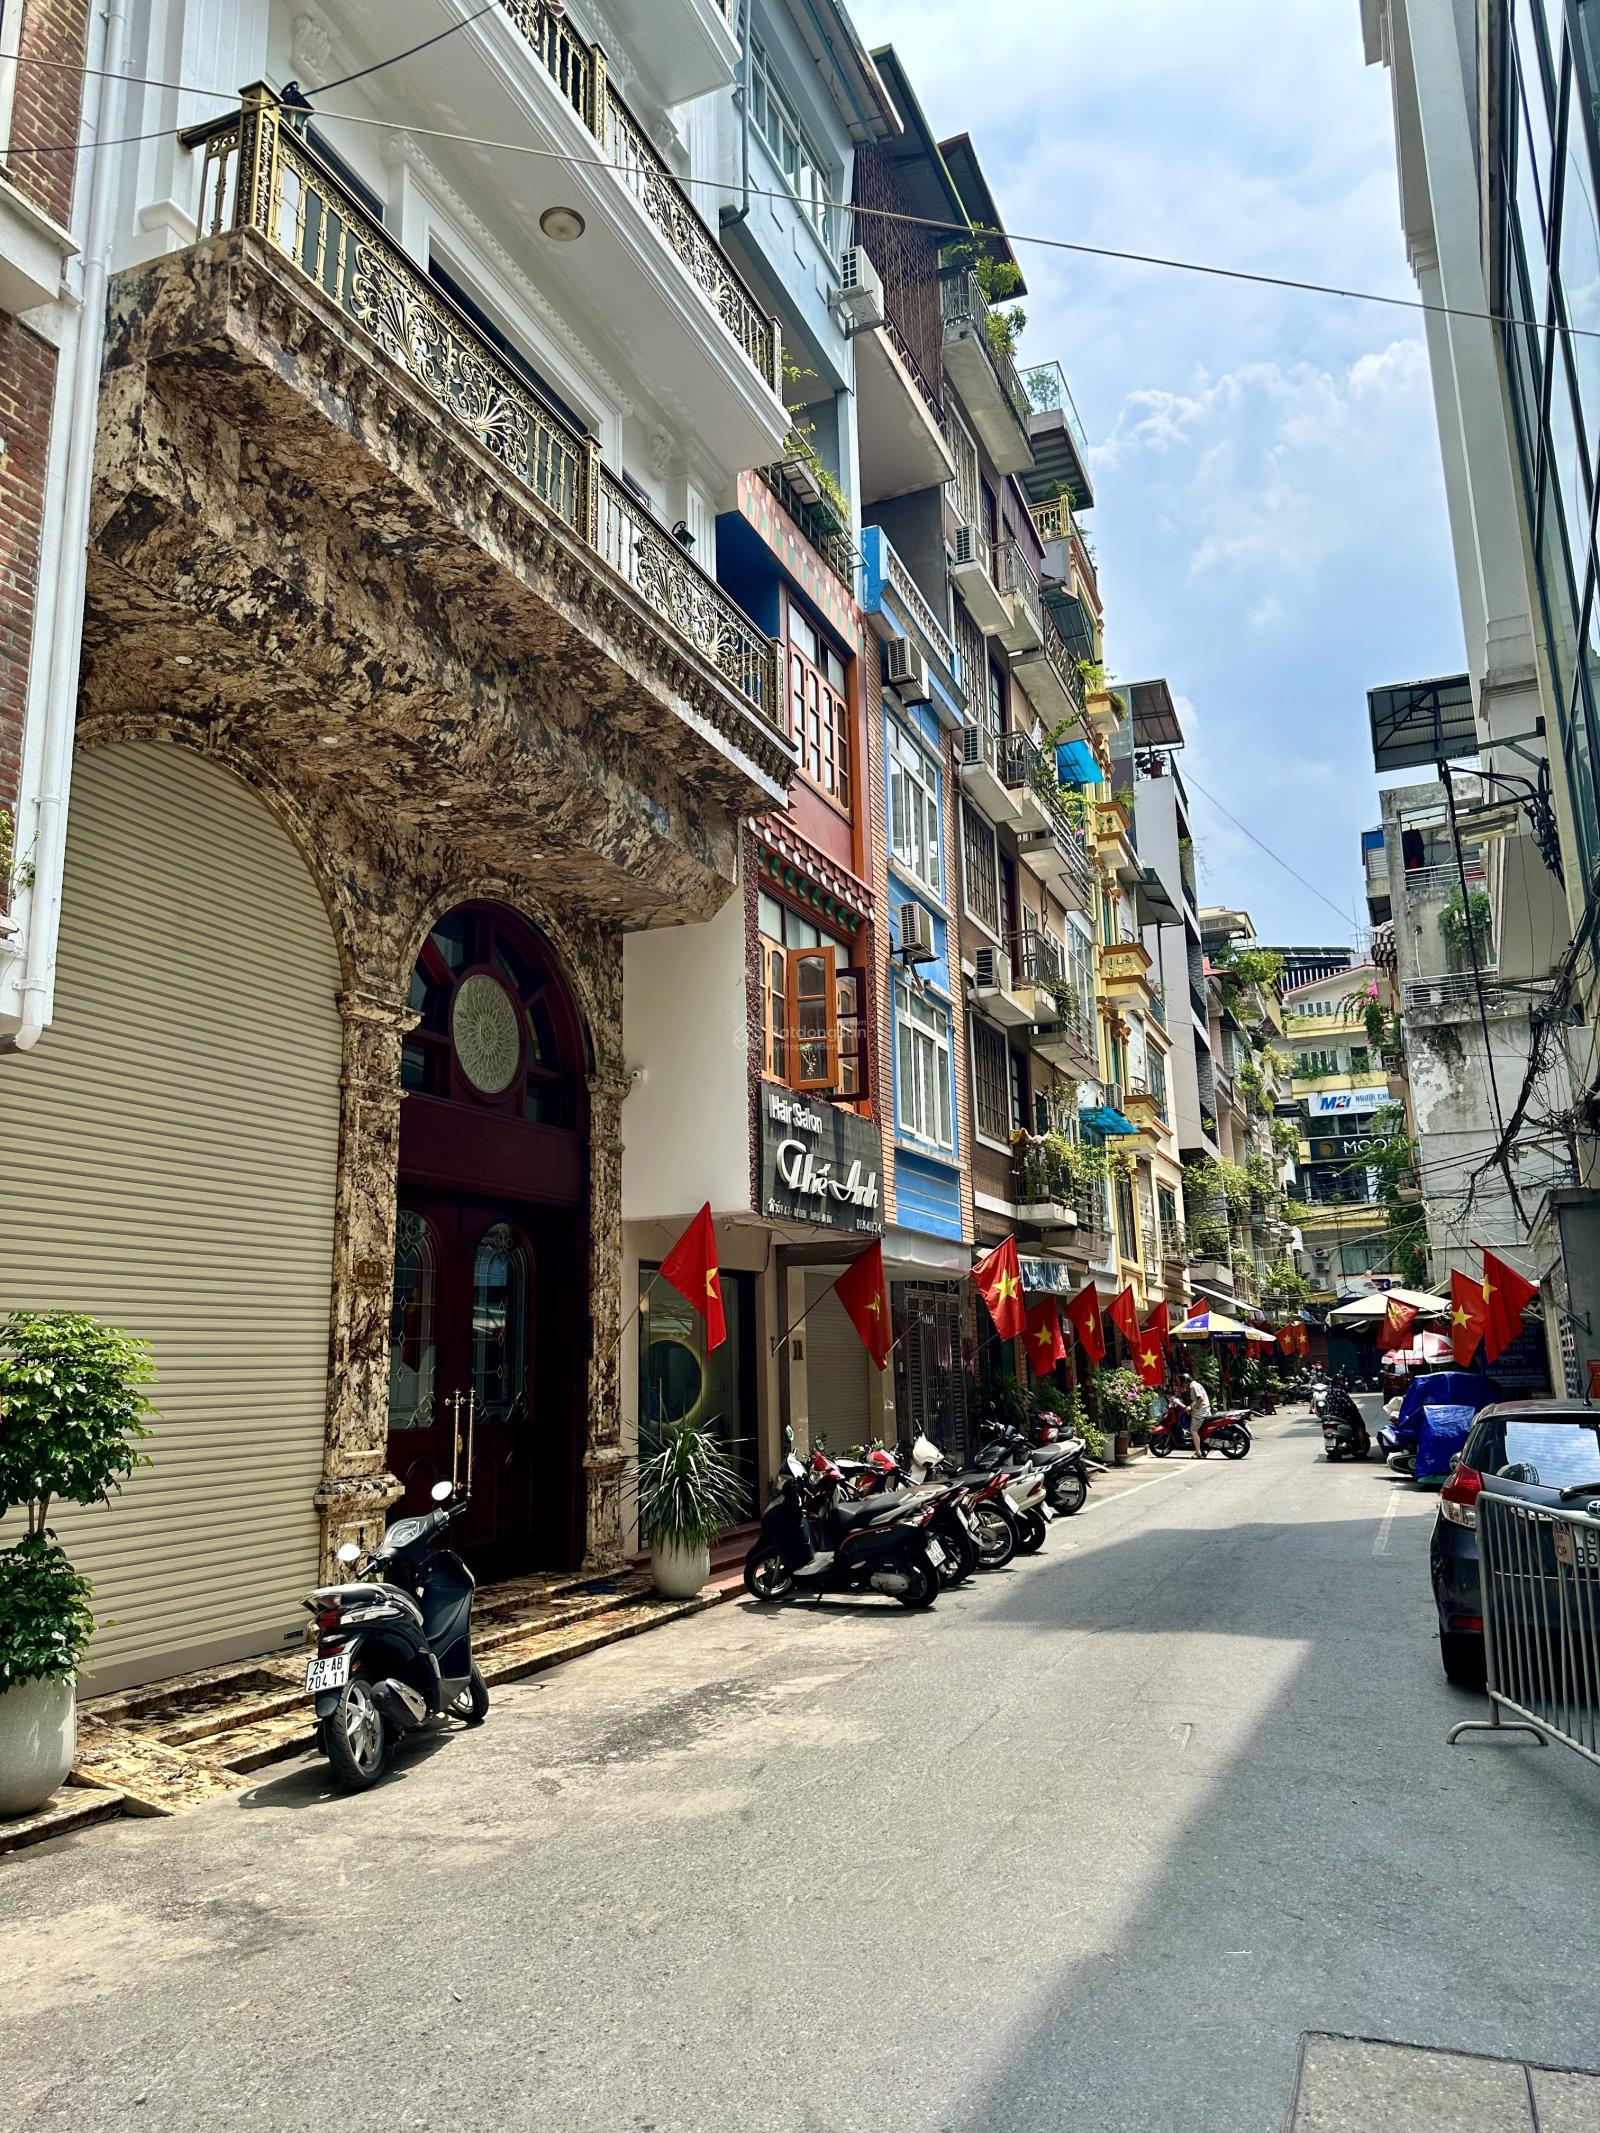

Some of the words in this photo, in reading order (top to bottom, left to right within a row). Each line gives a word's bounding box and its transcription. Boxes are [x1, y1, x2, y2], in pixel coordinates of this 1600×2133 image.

[769, 1093, 792, 1124] Hair
[792, 1103, 822, 1135] Salon
[828, 1160, 879, 1209] Anh
[308, 1670, 345, 1691] 204.11
[313, 1656, 343, 1675] 29-AB
